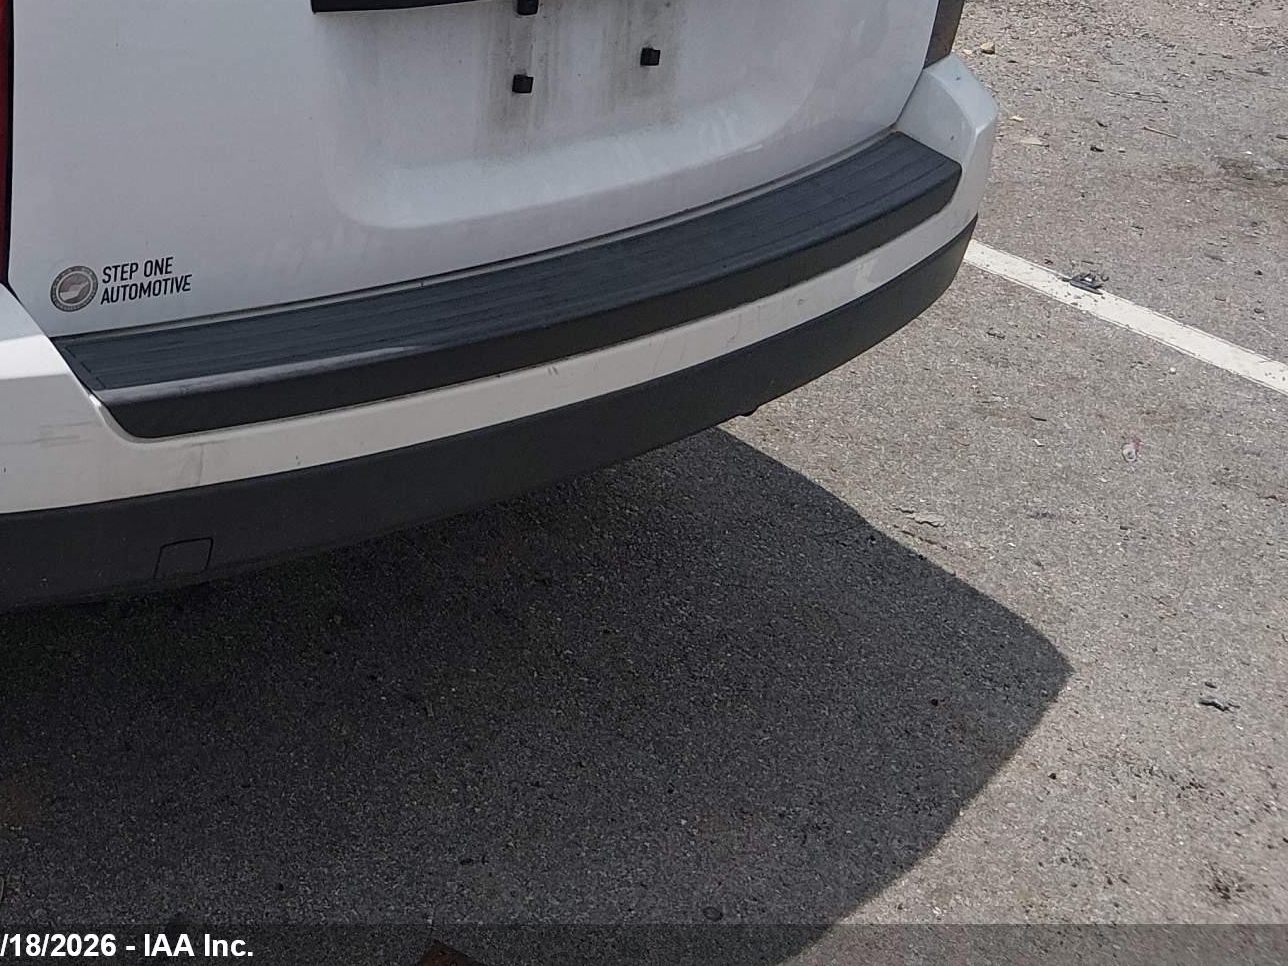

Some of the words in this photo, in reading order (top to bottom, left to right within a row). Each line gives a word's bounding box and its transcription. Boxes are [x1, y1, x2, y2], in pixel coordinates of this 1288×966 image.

[102, 262, 139, 284] STEP
[144, 256, 174, 278] ONE
[100, 274, 193, 305] AUTOMOTIVE
